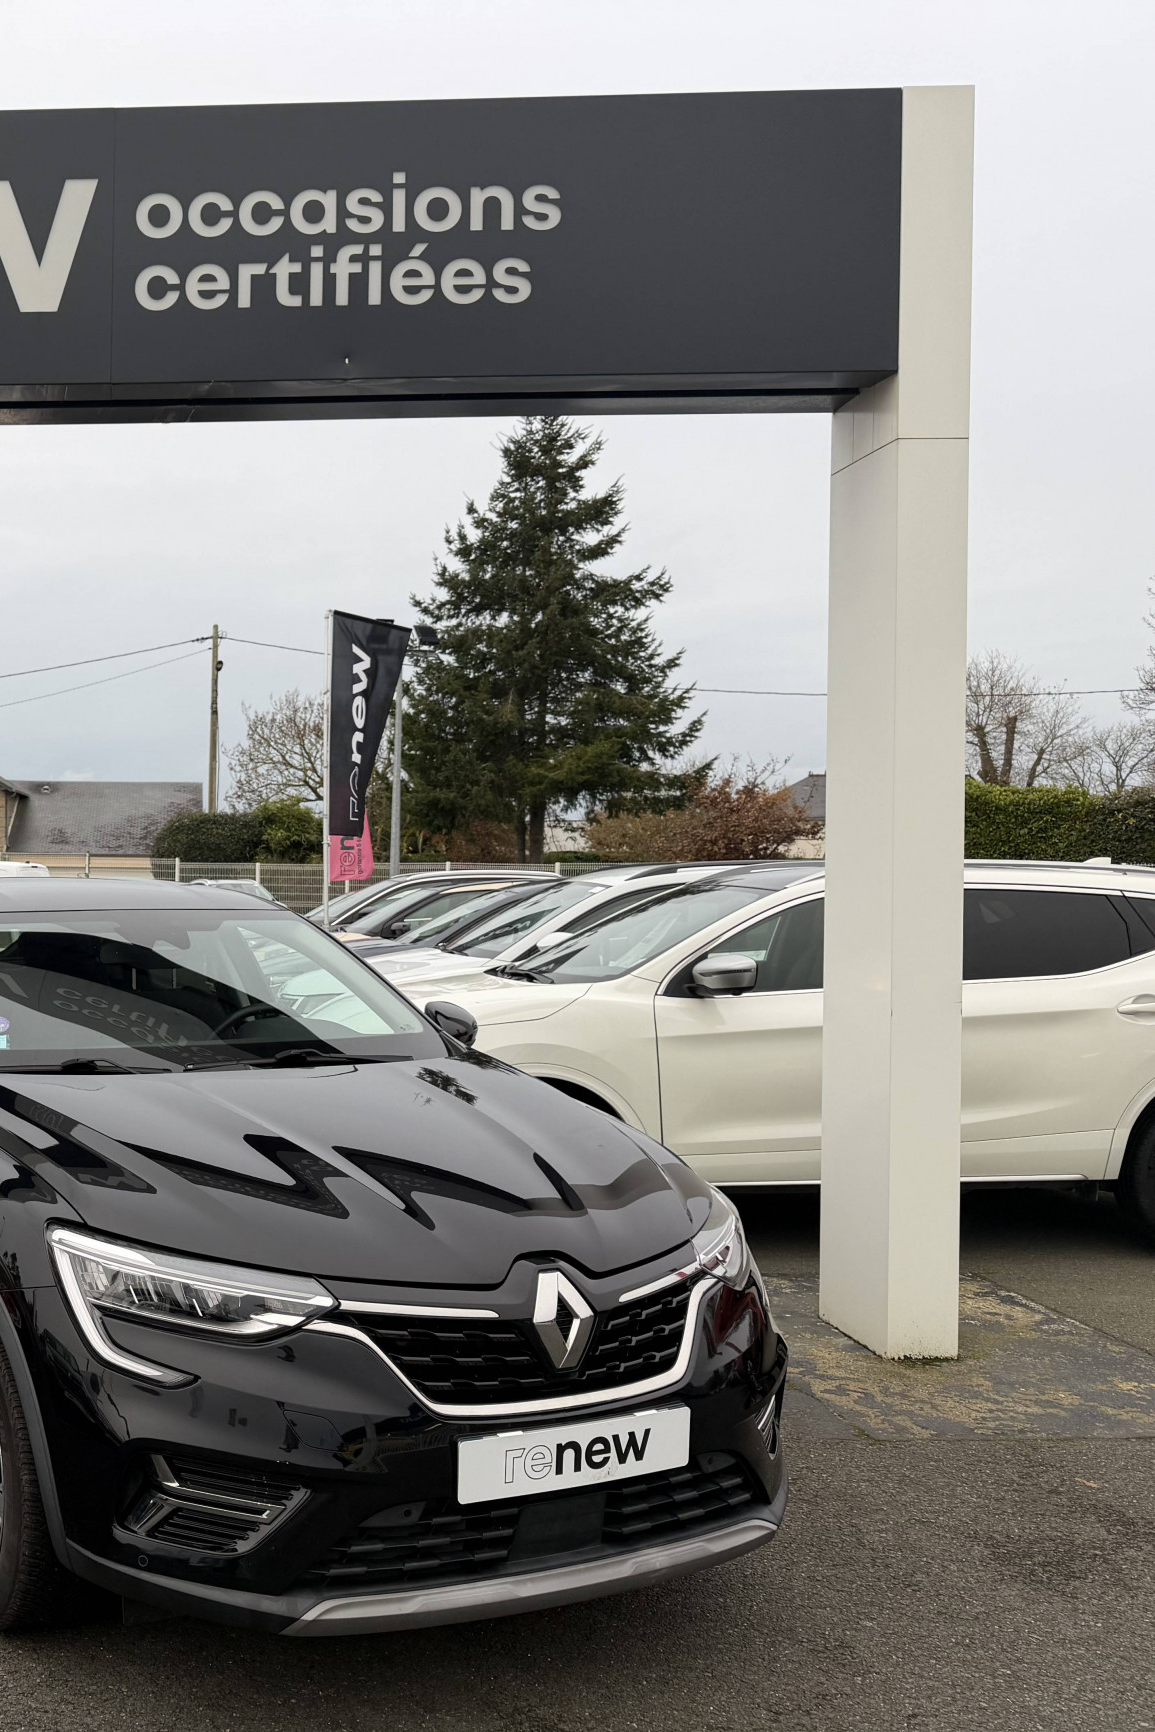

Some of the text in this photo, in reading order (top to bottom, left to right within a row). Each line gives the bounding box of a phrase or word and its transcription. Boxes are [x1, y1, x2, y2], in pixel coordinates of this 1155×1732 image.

[135, 171, 562, 239] occasions
[134, 242, 532, 311] certifiées
[339, 835, 355, 876] ren
[504, 1427, 652, 1485] renew
